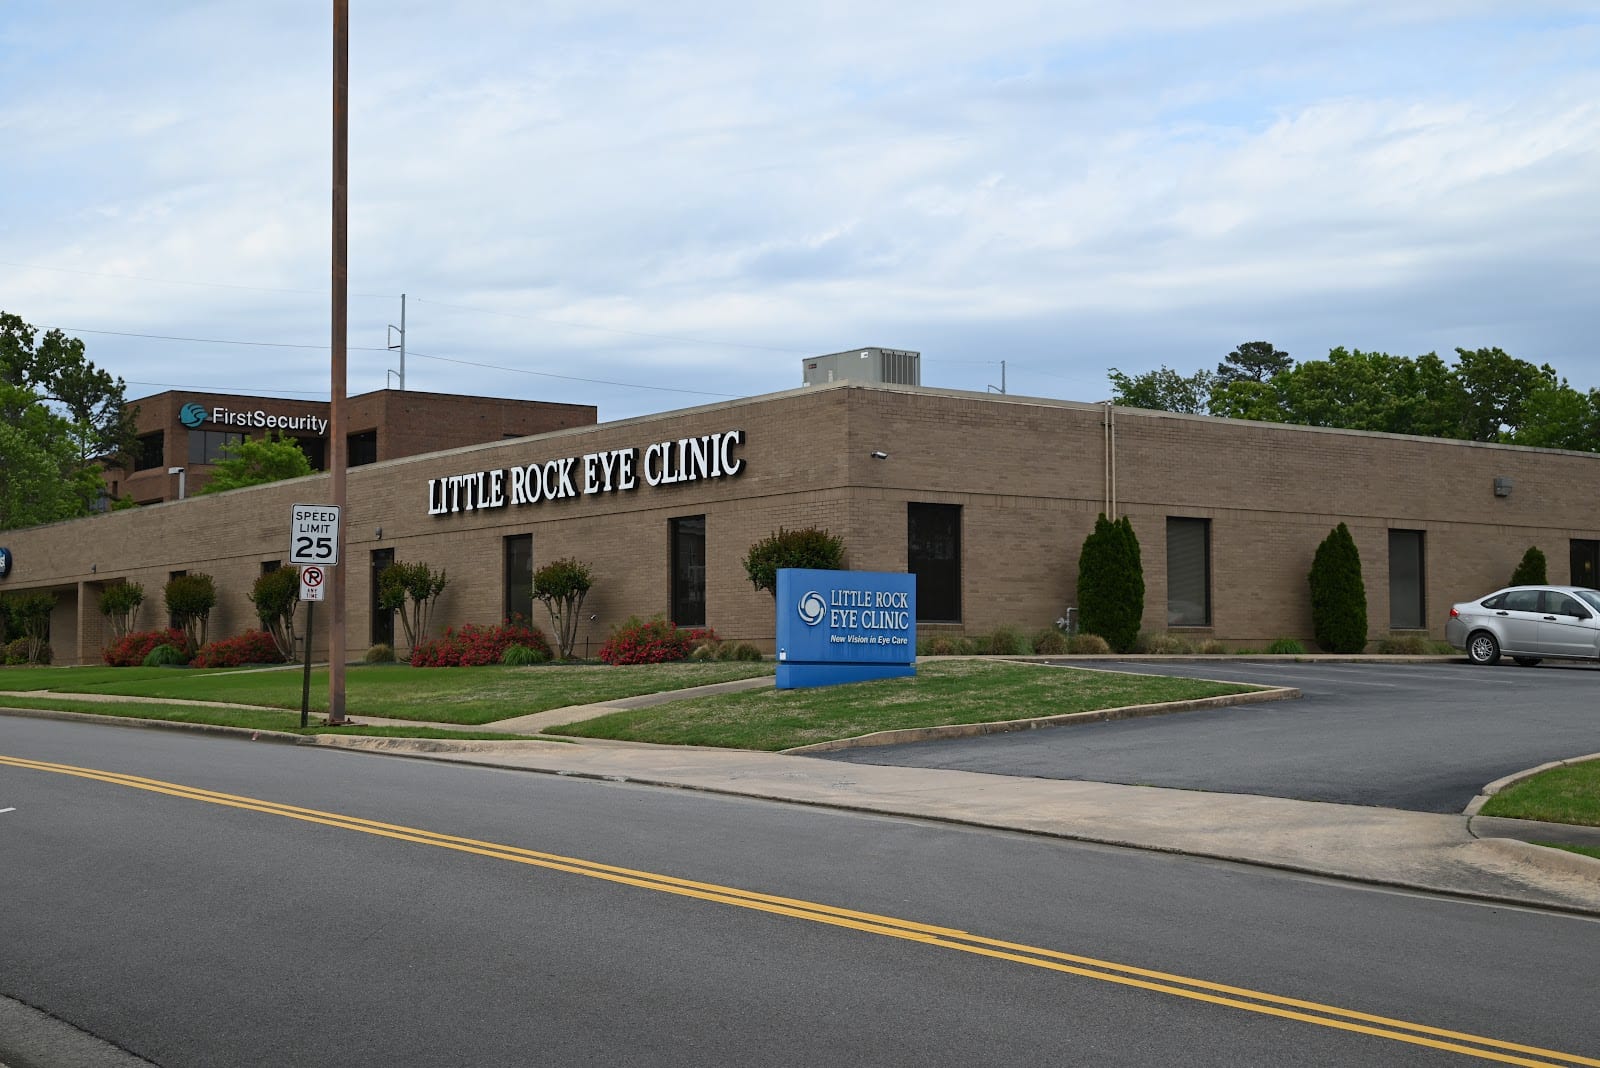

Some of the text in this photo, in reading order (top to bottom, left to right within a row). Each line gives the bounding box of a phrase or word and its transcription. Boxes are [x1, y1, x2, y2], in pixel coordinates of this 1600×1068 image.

[212, 407, 328, 435] FirstSecurity
[428, 430, 742, 515] LITTLE ROCK EYE CLINIC
[296, 512, 336, 521] SPEED
[300, 524, 330, 533] LIMIT
[296, 537, 332, 558] 25
[831, 590, 908, 608] LITTLE ROCK
[831, 609, 908, 629] EYE CLINIC
[831, 635, 908, 645] New Vision in Eye Care
